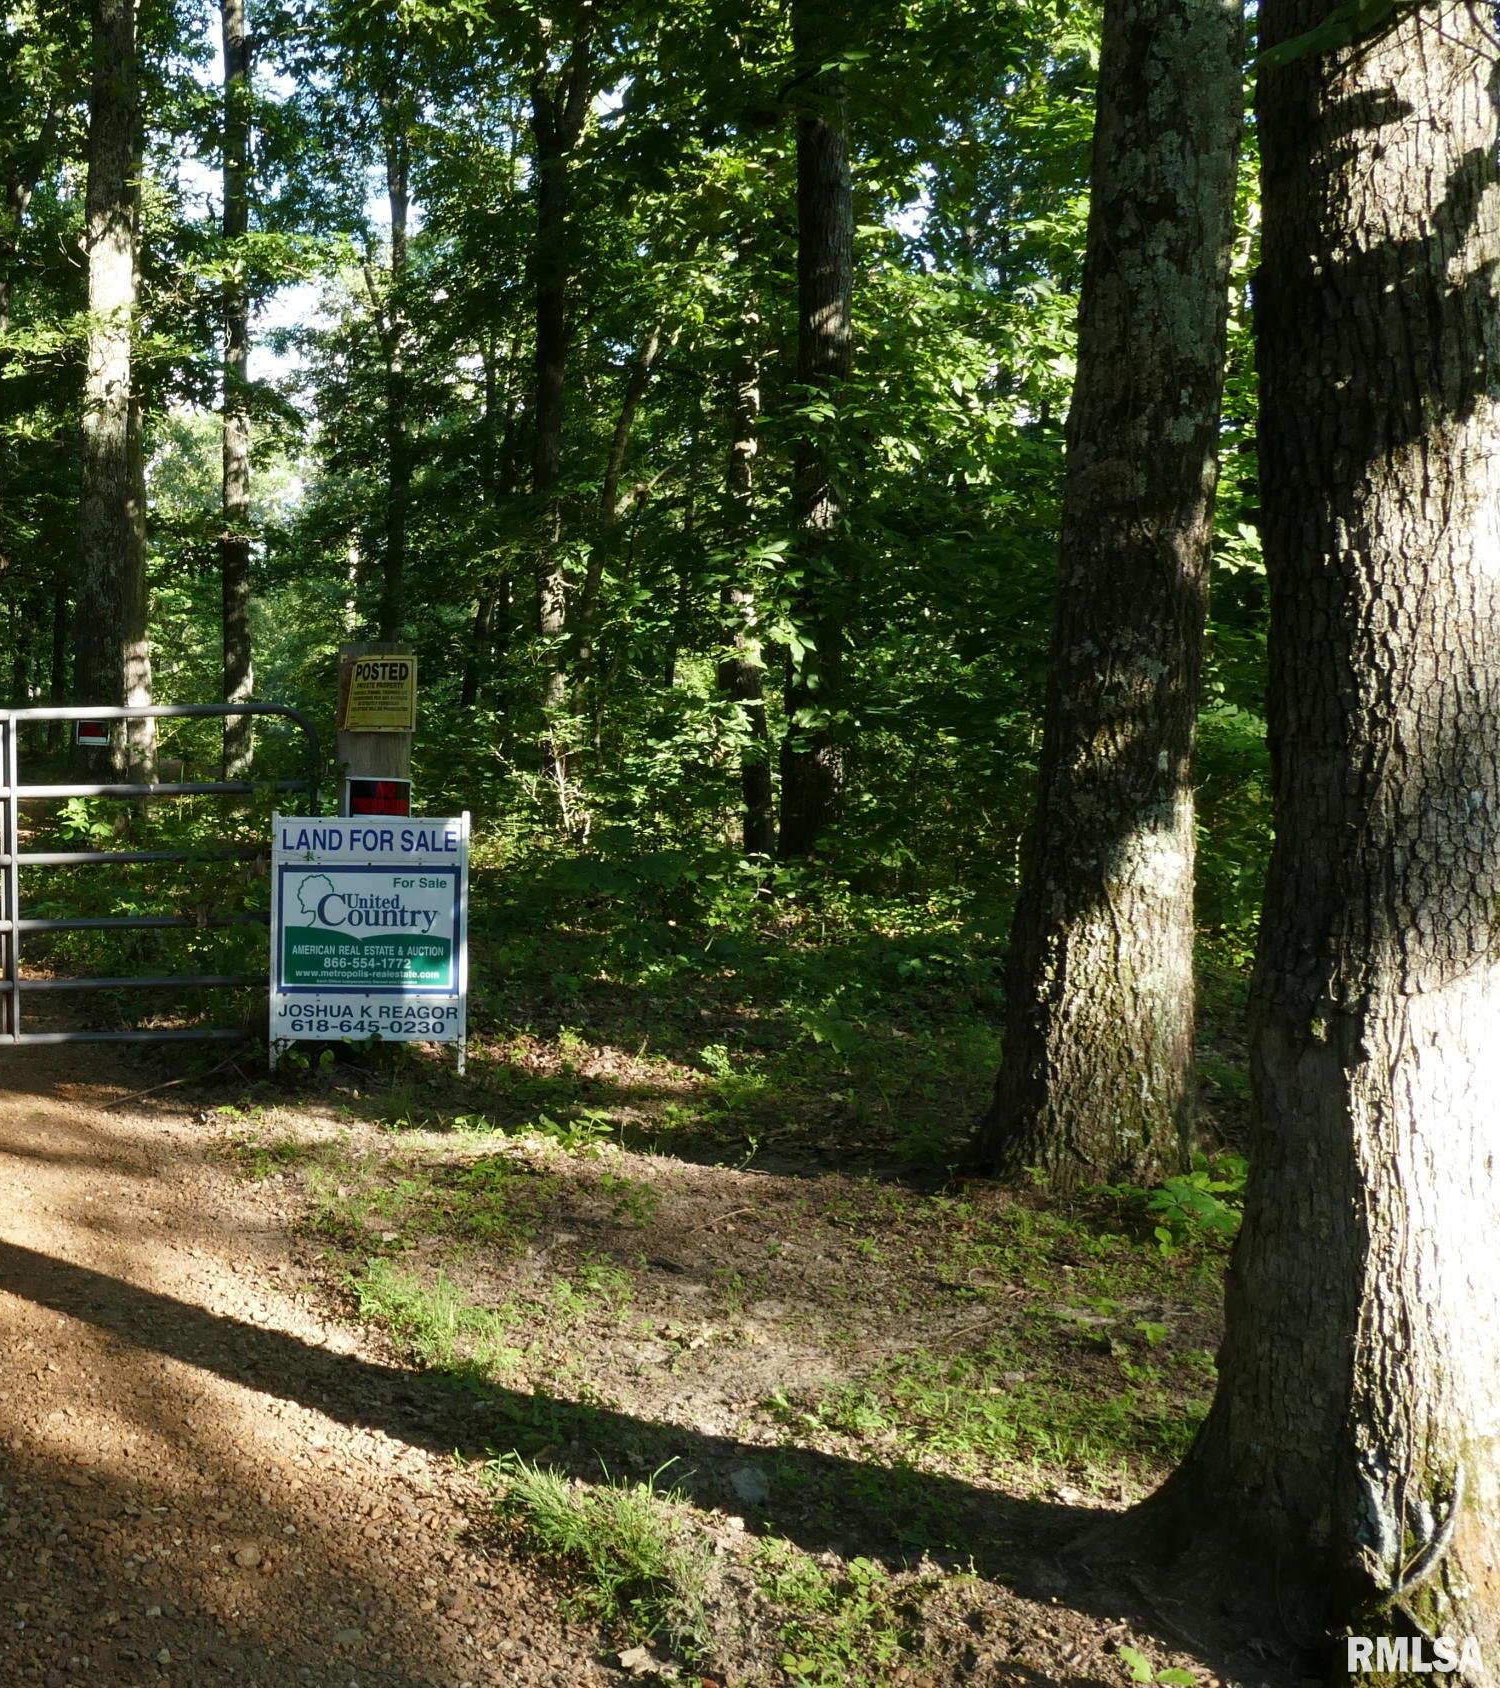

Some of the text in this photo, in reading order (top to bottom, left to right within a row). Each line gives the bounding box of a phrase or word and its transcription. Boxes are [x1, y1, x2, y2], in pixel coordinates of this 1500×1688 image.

[355, 662, 409, 681] POSTED
[282, 829, 457, 852] LAND FOR SALE
[393, 877, 447, 889] For Sale
[343, 893, 400, 909] United
[317, 893, 438, 933] Country
[292, 945, 444, 956] AMERICAN REAL ESTATE & AUCTION
[323, 957, 412, 969] 866-554-1772
[295, 969, 440, 979] www.metropolis-realestate.com
[278, 1004, 458, 1020] JOSHUA K REAGOR
[291, 1020, 445, 1034] 618-645-0230
